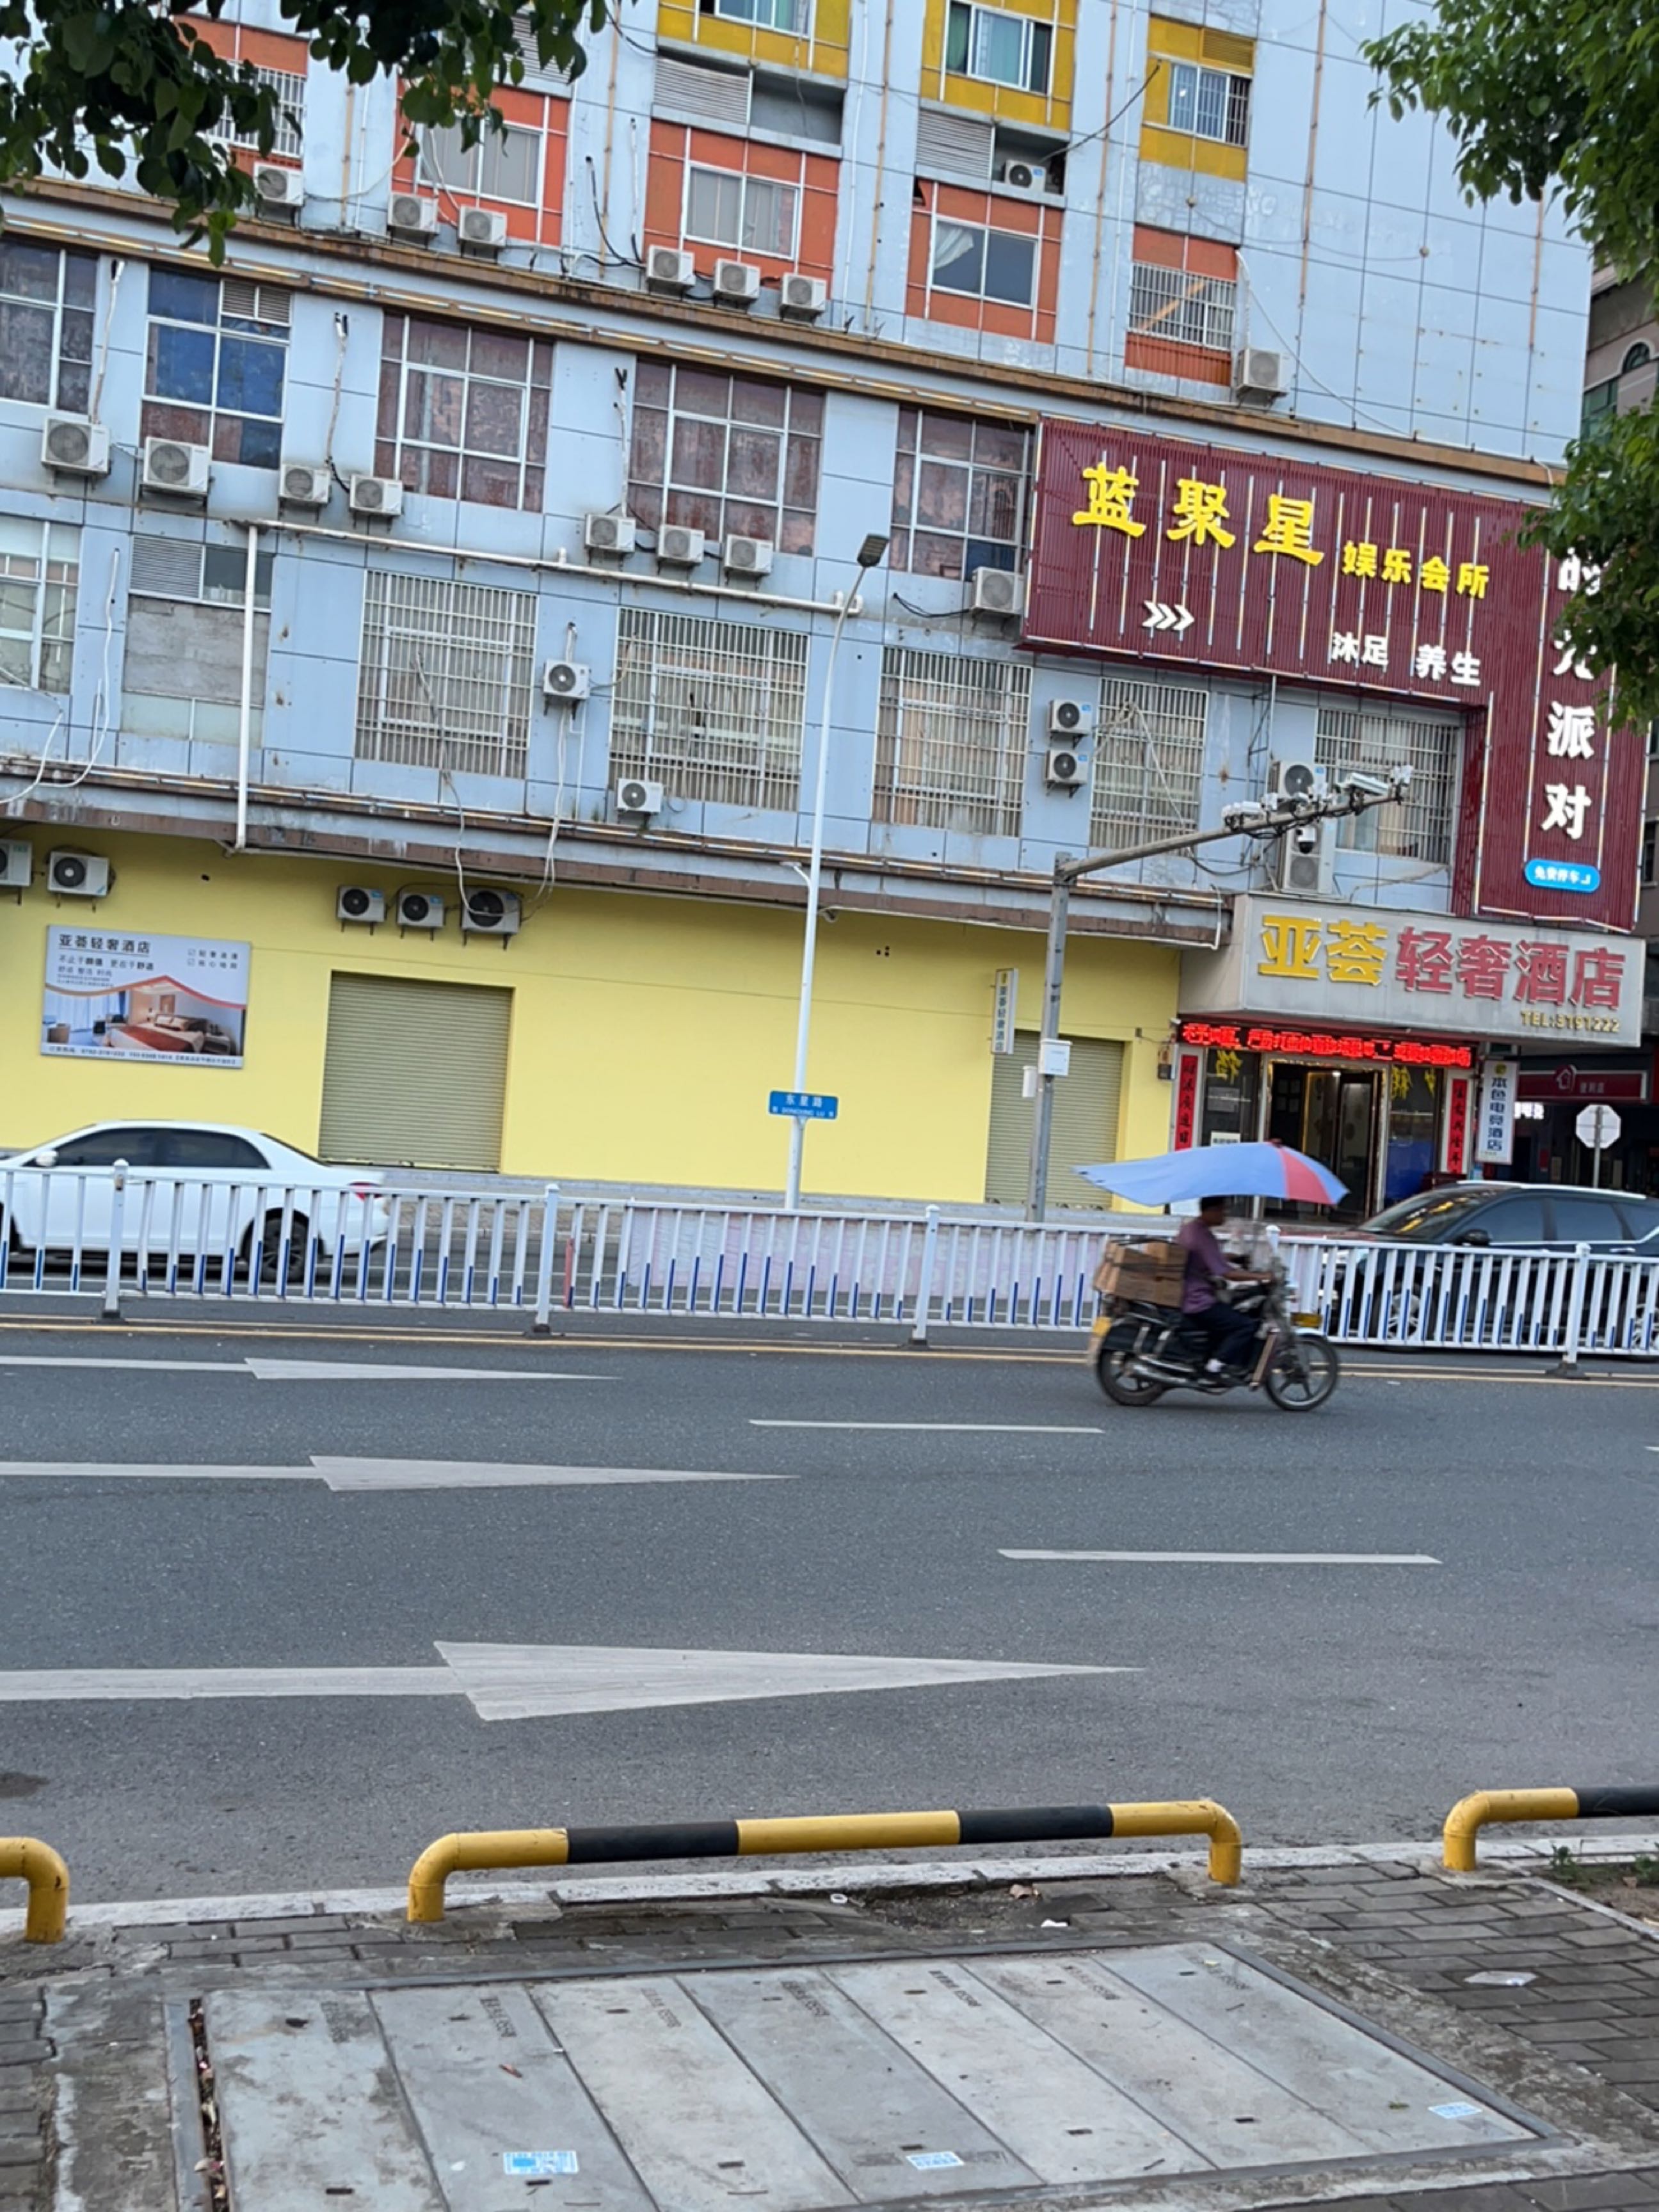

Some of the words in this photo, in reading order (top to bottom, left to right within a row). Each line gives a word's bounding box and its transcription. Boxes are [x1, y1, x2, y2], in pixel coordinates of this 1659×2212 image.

[1072, 461, 1324, 566] 蓝聚星
[1342, 540, 1490, 600] 娱乐会所
[1331, 630, 1390, 667] 沐足
[1416, 643, 1482, 686] 养生
[1521, 1010, 1621, 1034] TEL:3191222
[1487, 1077, 1507, 1151] 本色电竞酒店
